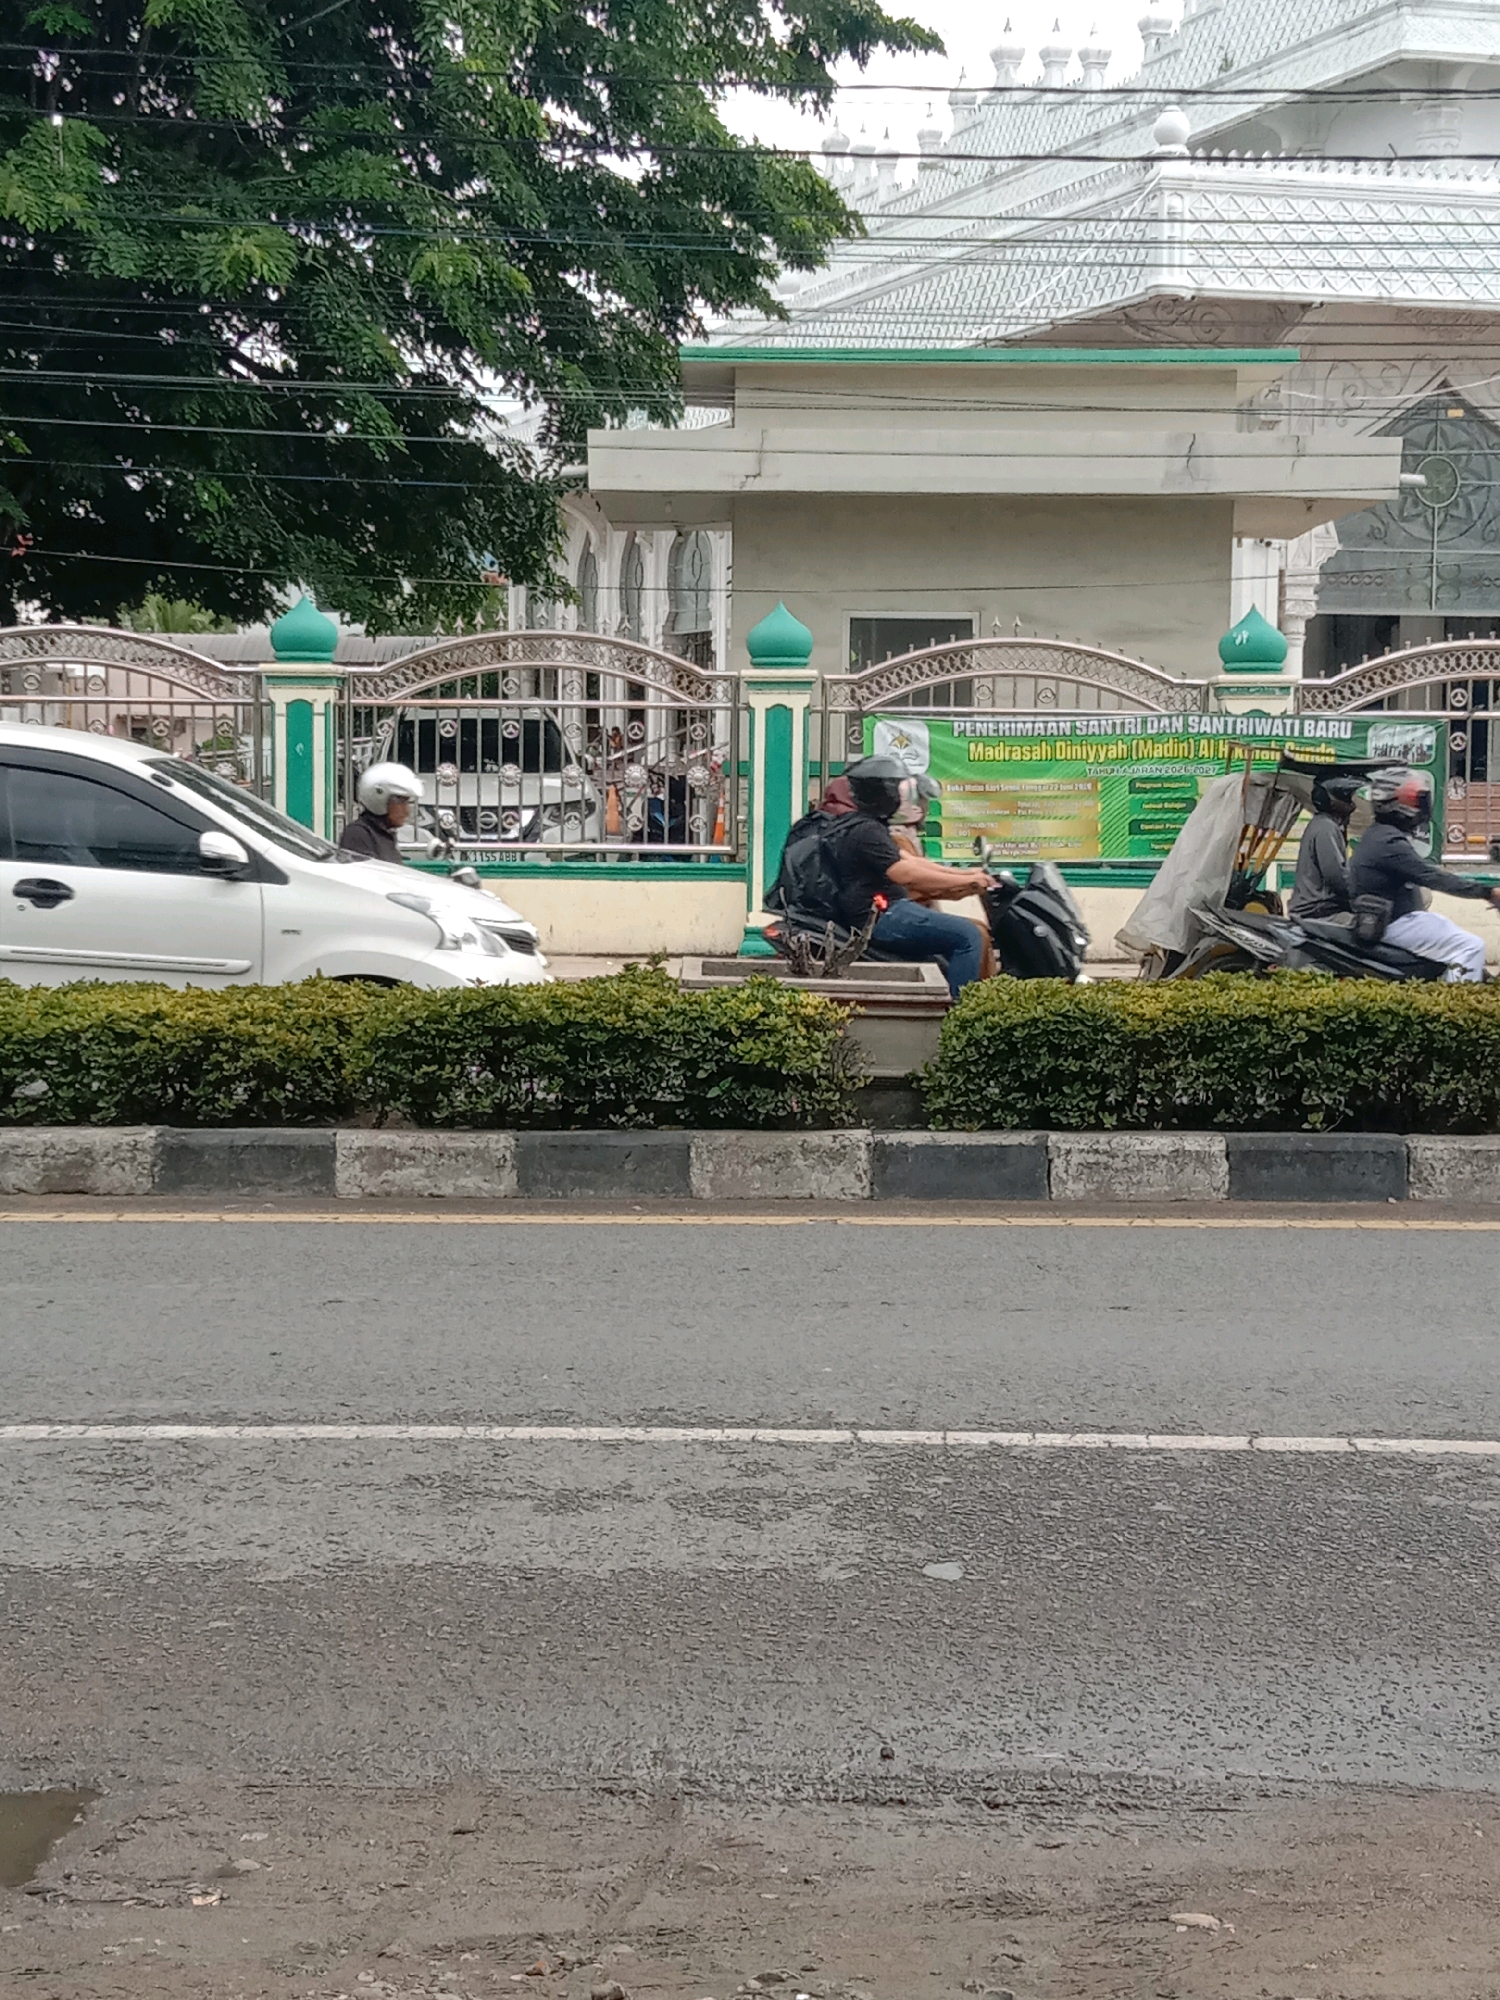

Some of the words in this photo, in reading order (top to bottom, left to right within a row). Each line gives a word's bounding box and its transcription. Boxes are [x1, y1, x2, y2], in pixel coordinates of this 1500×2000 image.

[953, 720, 1071, 738] PENERIMAAN
[1075, 719, 1144, 737] SANTRI
[1147, 717, 1184, 735] DAN
[1187, 715, 1300, 738] SANTRIWATI
[1303, 719, 1354, 739] BARU
[968, 740, 1052, 762] Madrasah
[1055, 740, 1128, 763] Diniyyah
[1131, 738, 1195, 761] (Madin)
[1199, 738, 1214, 759] Al
[1087, 766, 1119, 777] TAHUN
[1121, 766, 1163, 776] AJARAN
